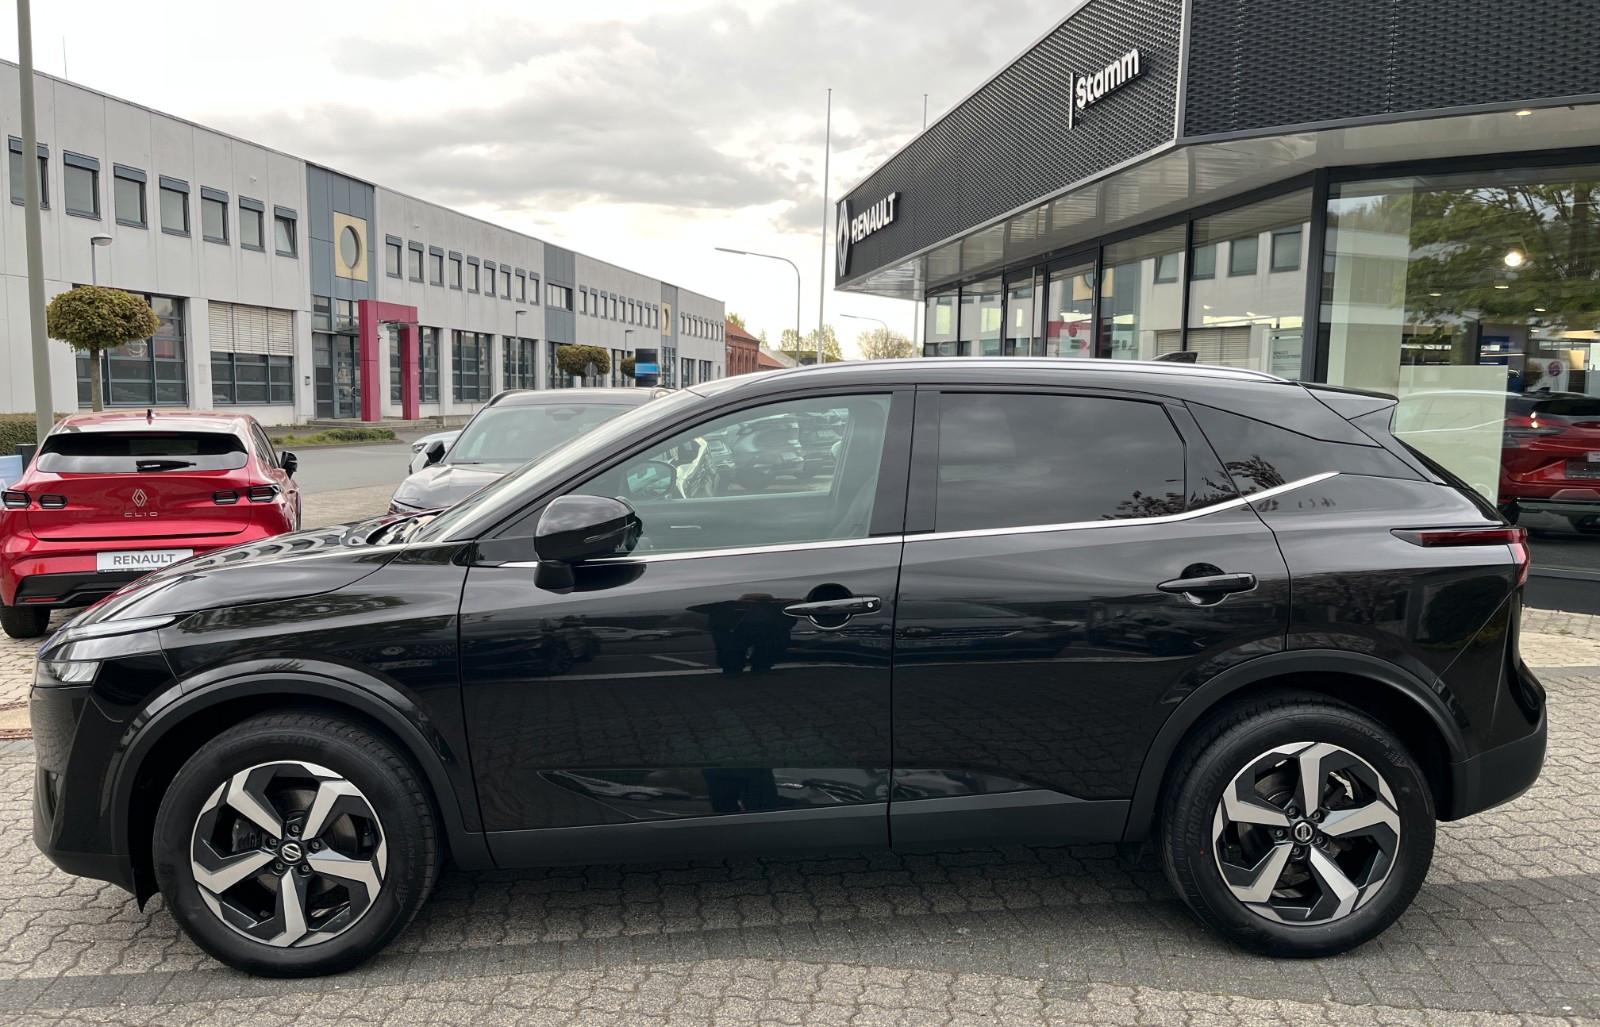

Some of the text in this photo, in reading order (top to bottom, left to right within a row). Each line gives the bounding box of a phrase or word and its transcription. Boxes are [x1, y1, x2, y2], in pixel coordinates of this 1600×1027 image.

[1076, 48, 1139, 109] Stamm
[851, 191, 896, 245] RENAULT
[113, 553, 175, 566] RENAULT
